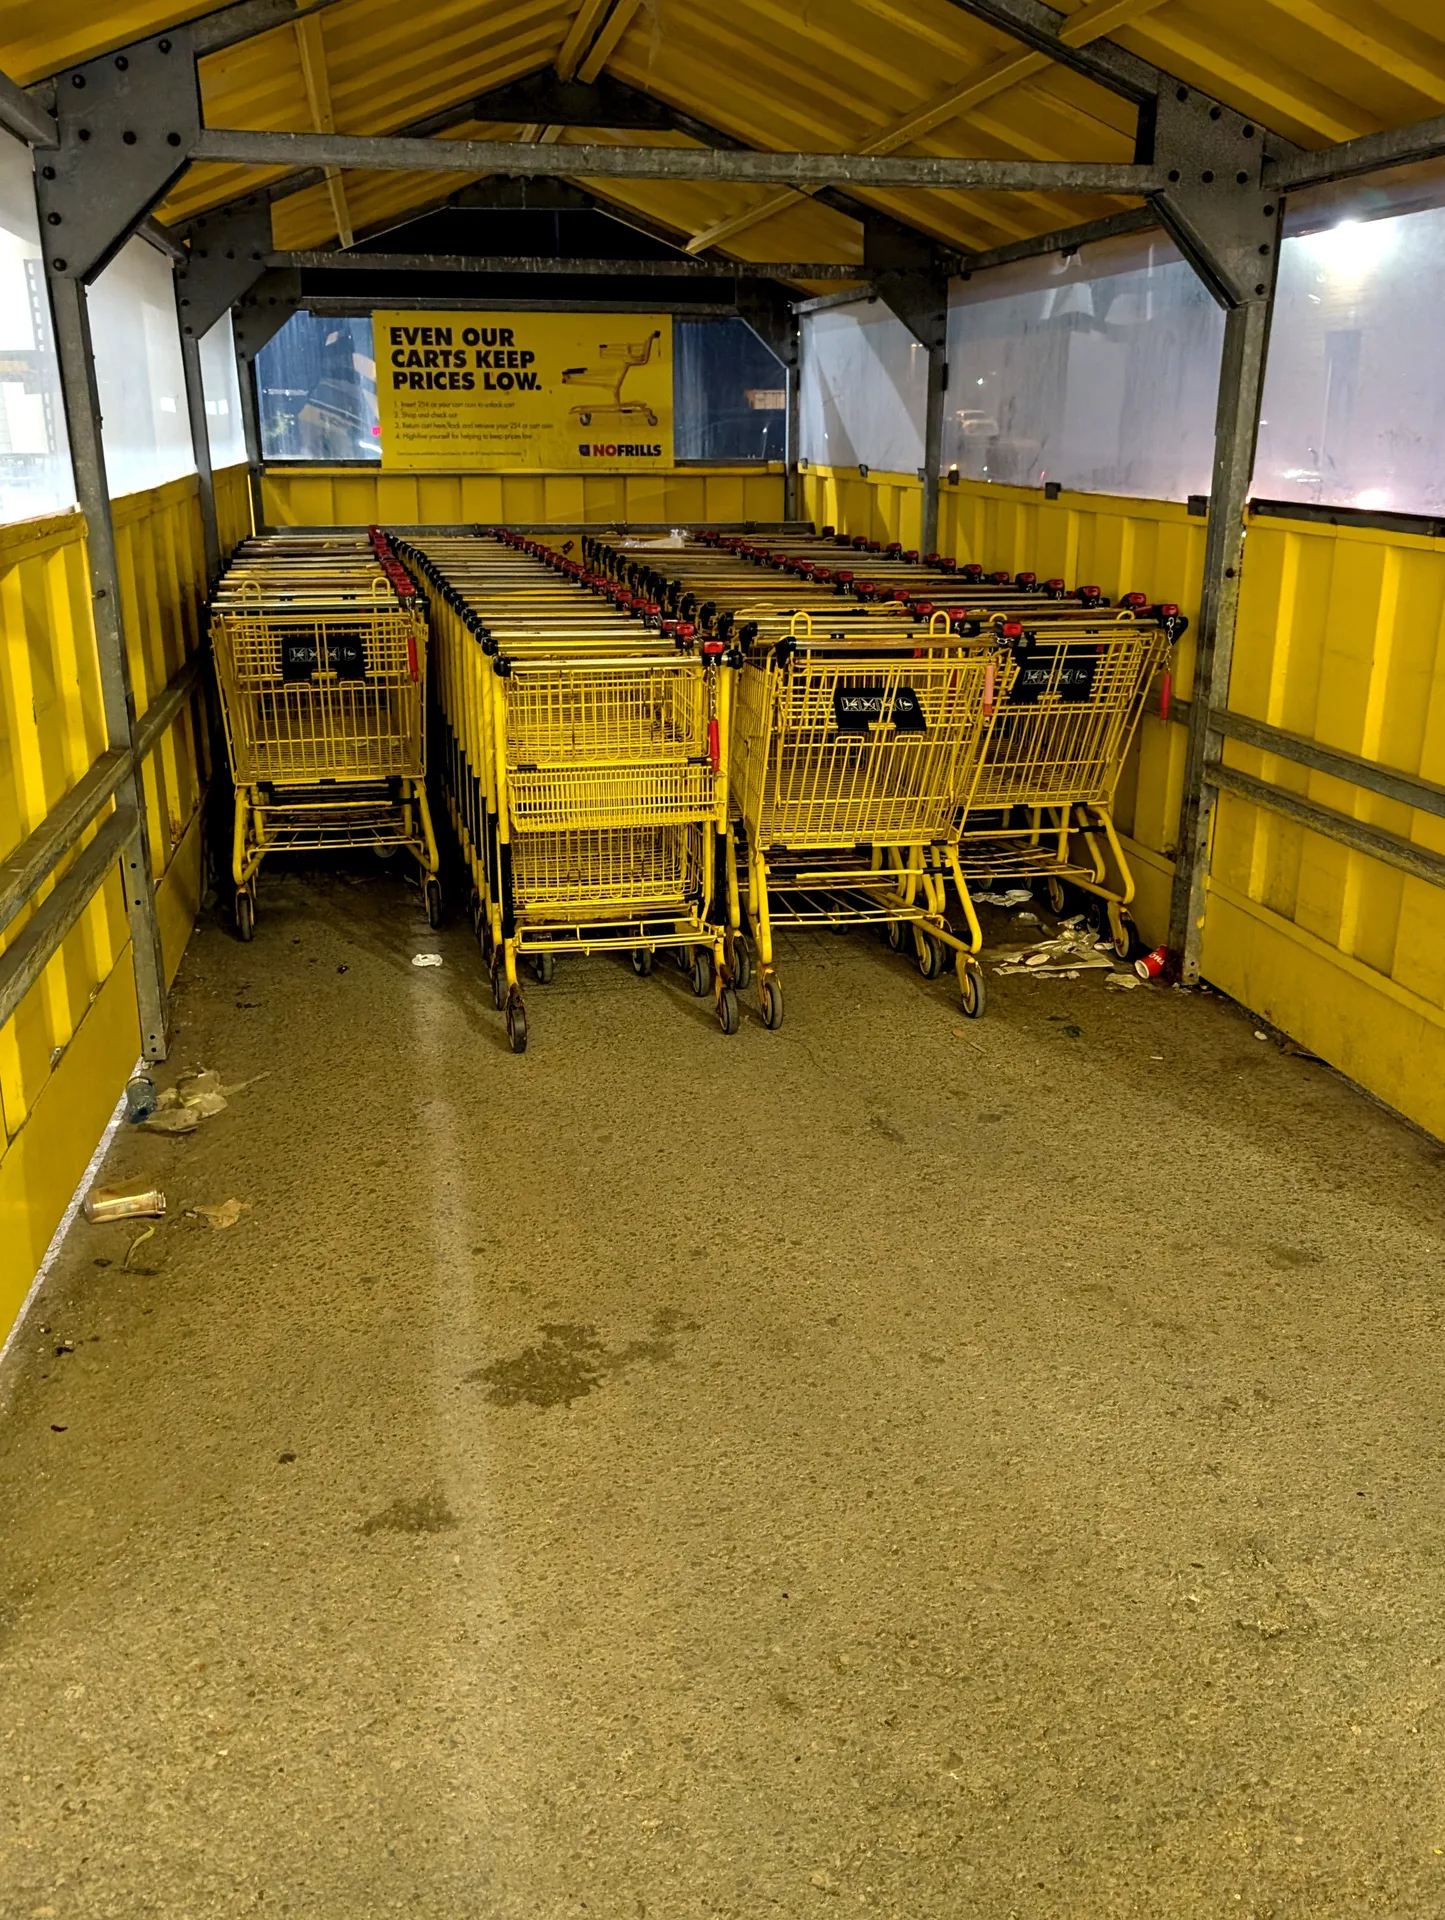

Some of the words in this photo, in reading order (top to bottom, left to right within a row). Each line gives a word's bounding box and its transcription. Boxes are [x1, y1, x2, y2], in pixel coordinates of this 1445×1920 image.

[390, 327, 452, 346] EVEN
[462, 327, 515, 347] OUR
[391, 349, 467, 368] CARTS
[476, 350, 535, 369] KEEP
[393, 371, 476, 390] PRICES
[483, 372, 542, 391] LOW.
[438, 401, 451, 409] your
[401, 411, 417, 419] Shop
[496, 422, 509, 430] your
[429, 432, 450, 440] yourself
[460, 432, 482, 440] helping
[489, 432, 504, 440] keep
[504, 432, 521, 440] prices
